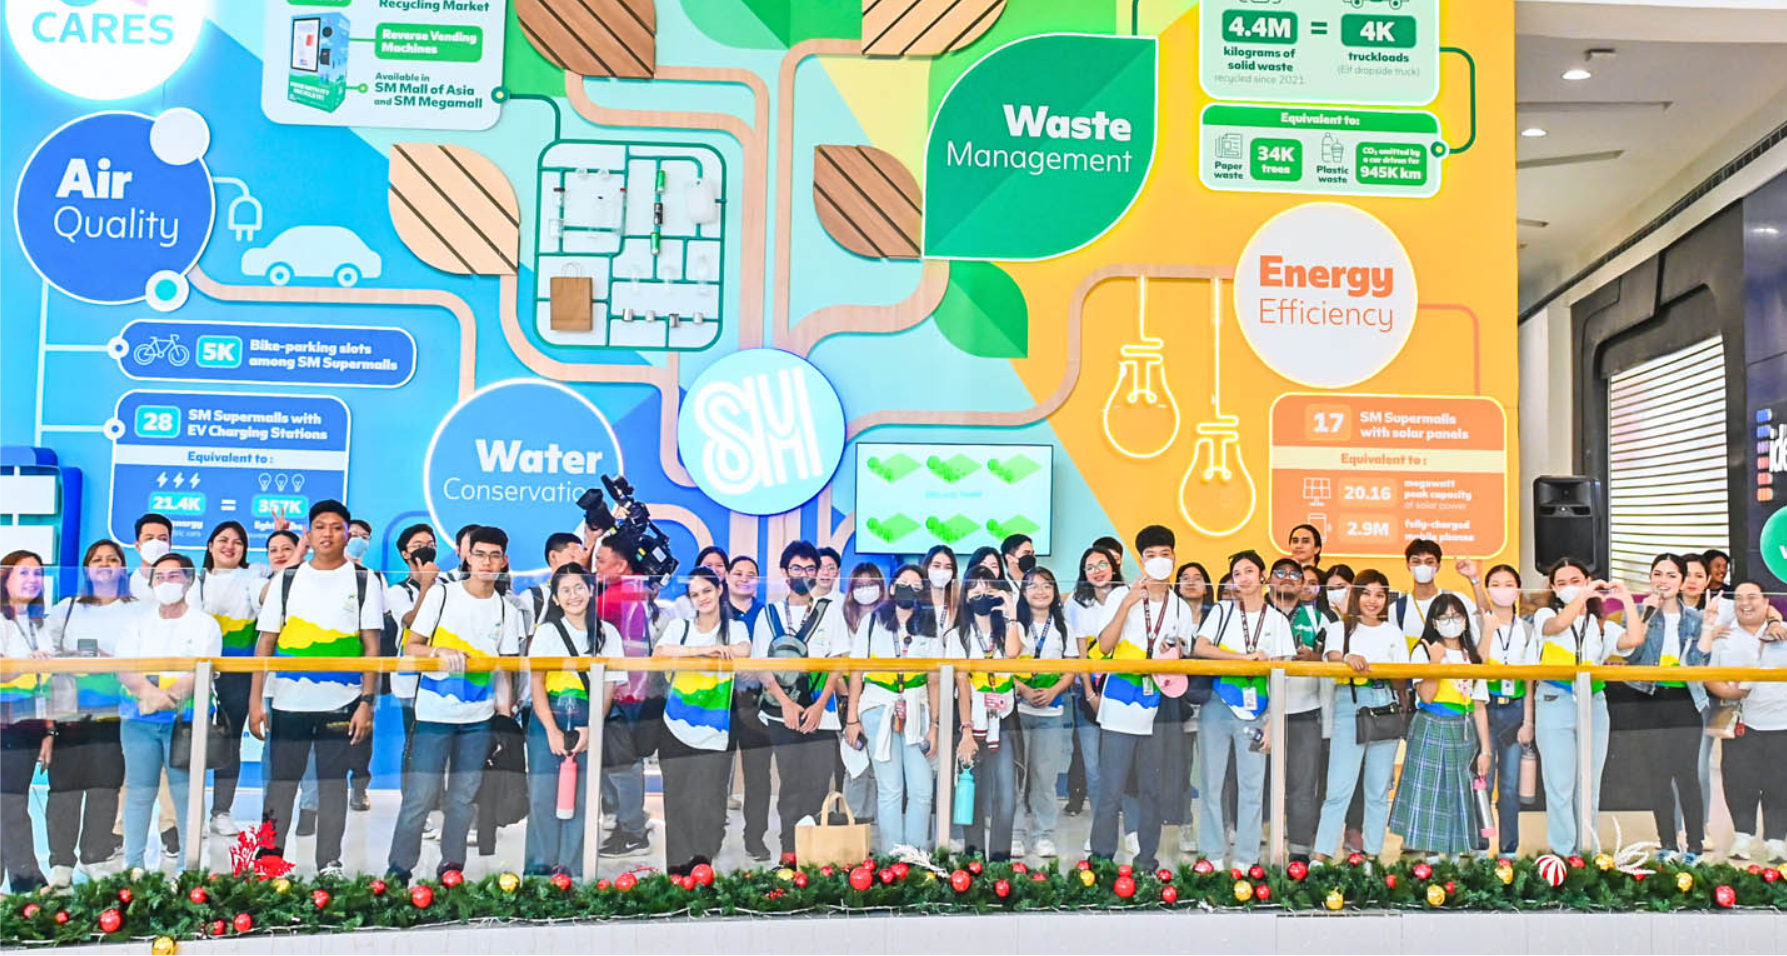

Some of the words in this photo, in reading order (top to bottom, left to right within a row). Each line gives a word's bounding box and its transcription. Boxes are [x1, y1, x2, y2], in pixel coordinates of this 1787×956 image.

[379, 0, 440, 12] Recycling
[443, 0, 489, 11] Market
[32, 12, 174, 45] CARES
[1228, 16, 1291, 38] 4.4M
[1360, 20, 1395, 42] 4K
[382, 28, 428, 41] Reverse
[429, 30, 477, 45] Vending
[381, 41, 438, 54] Machines
[1223, 46, 1281, 60] kilograms
[1283, 48, 1296, 59] of
[1349, 52, 1410, 63] truckloads
[1228, 60, 1255, 71] solid
[1257, 62, 1294, 72] waste
[375, 72, 419, 82] Available
[421, 74, 430, 82] in
[1254, 75, 1277, 84] since
[374, 82, 396, 93] SM
[399, 83, 428, 94] Mall
[430, 84, 444, 95] of
[447, 85, 475, 96] Asia
[374, 97, 392, 106] and
[394, 96, 416, 107] SM
[419, 97, 483, 110] Megamall
[1003, 104, 1132, 141] Waste
[1280, 112, 1342, 126] Equivalent
[1344, 114, 1360, 126] to:
[947, 141, 1133, 175] Management
[1257, 146, 1295, 162] 34K
[1379, 147, 1409, 156] emitted
[1410, 149, 1421, 157] by
[1214, 161, 1243, 172] Paper
[1382, 156, 1407, 164] driven
[1214, 171, 1243, 180] waste
[1261, 163, 1291, 174] trees
[1316, 165, 1349, 175] Plastic
[1360, 166, 1399, 179] 945K
[1400, 167, 1421, 179] km
[55, 158, 133, 199] Air
[1318, 175, 1348, 184] waste
[54, 206, 179, 248] Quality
[1259, 255, 1394, 298] Energy
[1259, 298, 1393, 333] Efficiency
[202, 342, 235, 362] 5K
[249, 338, 337, 355] Bike-parking
[339, 342, 372, 355] slots
[249, 357, 295, 371] among
[297, 357, 321, 369] SM
[322, 358, 398, 372] Supermalls
[143, 411, 173, 432] 28
[188, 408, 210, 421] SM
[213, 409, 289, 424] Supermalls
[291, 412, 322, 425] with
[1313, 412, 1344, 433] 17
[1360, 411, 1382, 423] SM
[1384, 411, 1457, 426] Supermalls
[187, 424, 208, 437] EV
[209, 425, 269, 442] Charging
[271, 426, 328, 440] Stations
[693, 365, 824, 495] SM
[1360, 426, 1390, 438] with
[1392, 427, 1424, 439] solar
[1426, 429, 1470, 442] panels
[187, 451, 252, 464] Equivalent
[475, 438, 603, 475] Water
[1340, 452, 1405, 466] Equivalent
[443, 477, 585, 502] Conservatio
[1404, 480, 1455, 490] megawatt
[1344, 486, 1392, 501] 20.16
[1404, 490, 1428, 500] peak
[1430, 490, 1471, 502] capacity
[152, 496, 201, 511] 21.4K
[258, 499, 302, 514] 357K
[1346, 521, 1390, 536] 2.9M
[1404, 519, 1471, 531] fully-charged
[1439, 532, 1475, 543] phones
